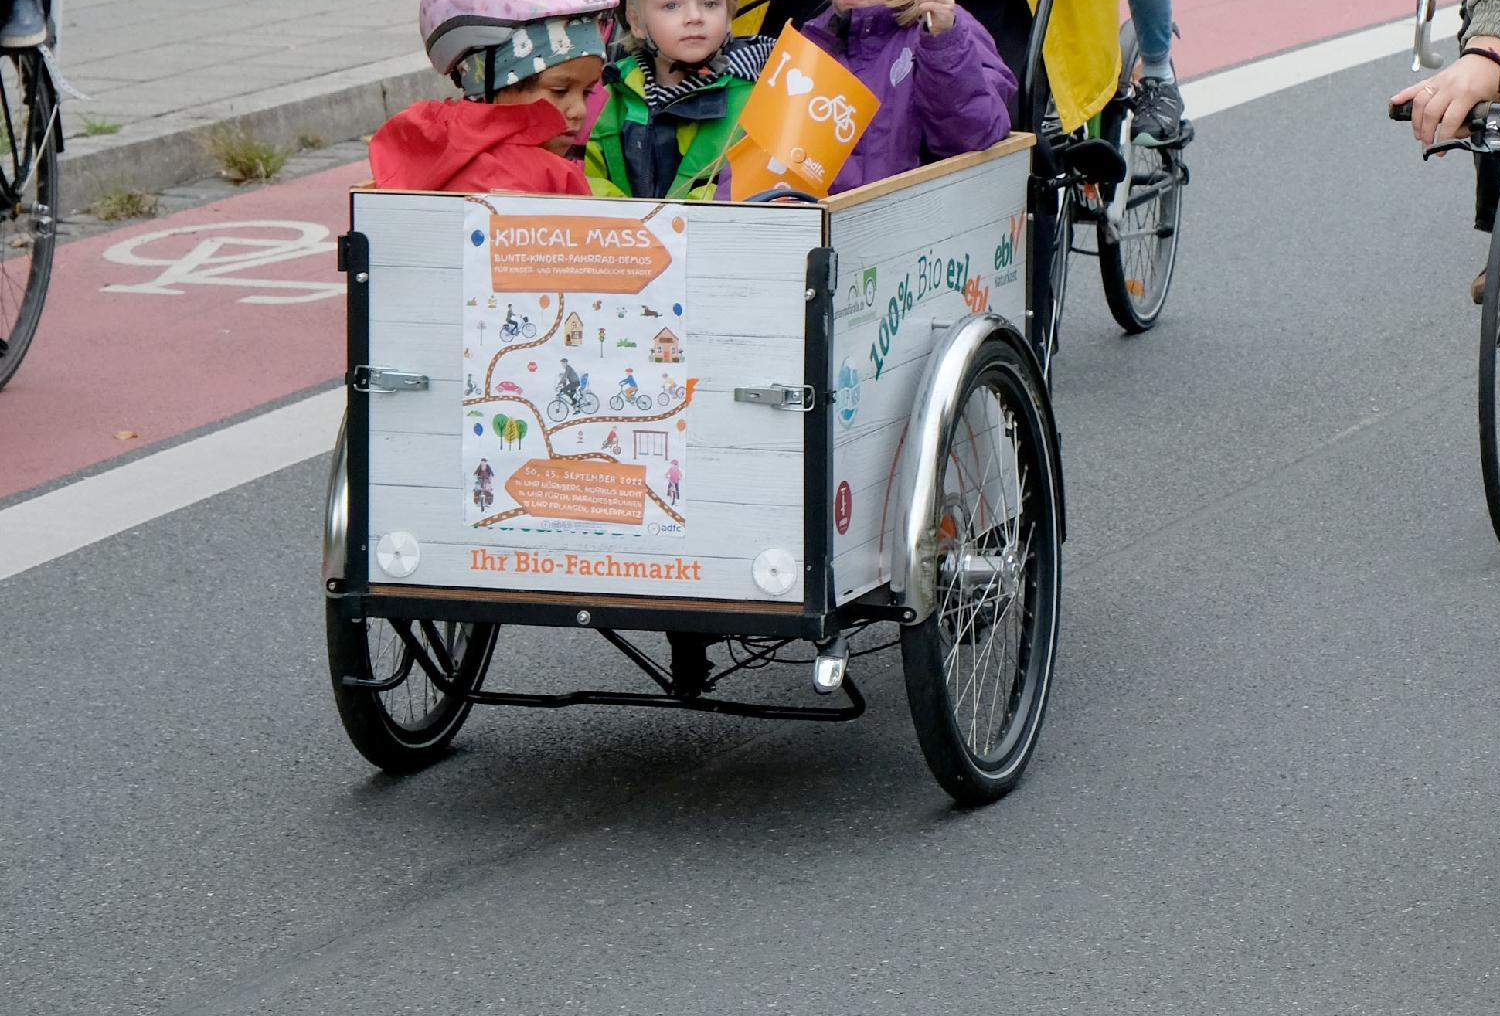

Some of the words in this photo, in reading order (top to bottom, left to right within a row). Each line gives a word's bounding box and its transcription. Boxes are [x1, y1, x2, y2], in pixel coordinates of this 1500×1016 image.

[494, 227, 578, 248] KIDICAL
[586, 228, 651, 248] MASS
[870, 273, 914, 382] 100%
[917, 250, 943, 301] Bio
[564, 471, 616, 484] SEPTEMBER
[620, 476, 642, 486] 2022
[661, 522, 682, 533] adfc
[470, 547, 507, 572] Ihr
[514, 551, 702, 581] Bio-Fachmarkt
